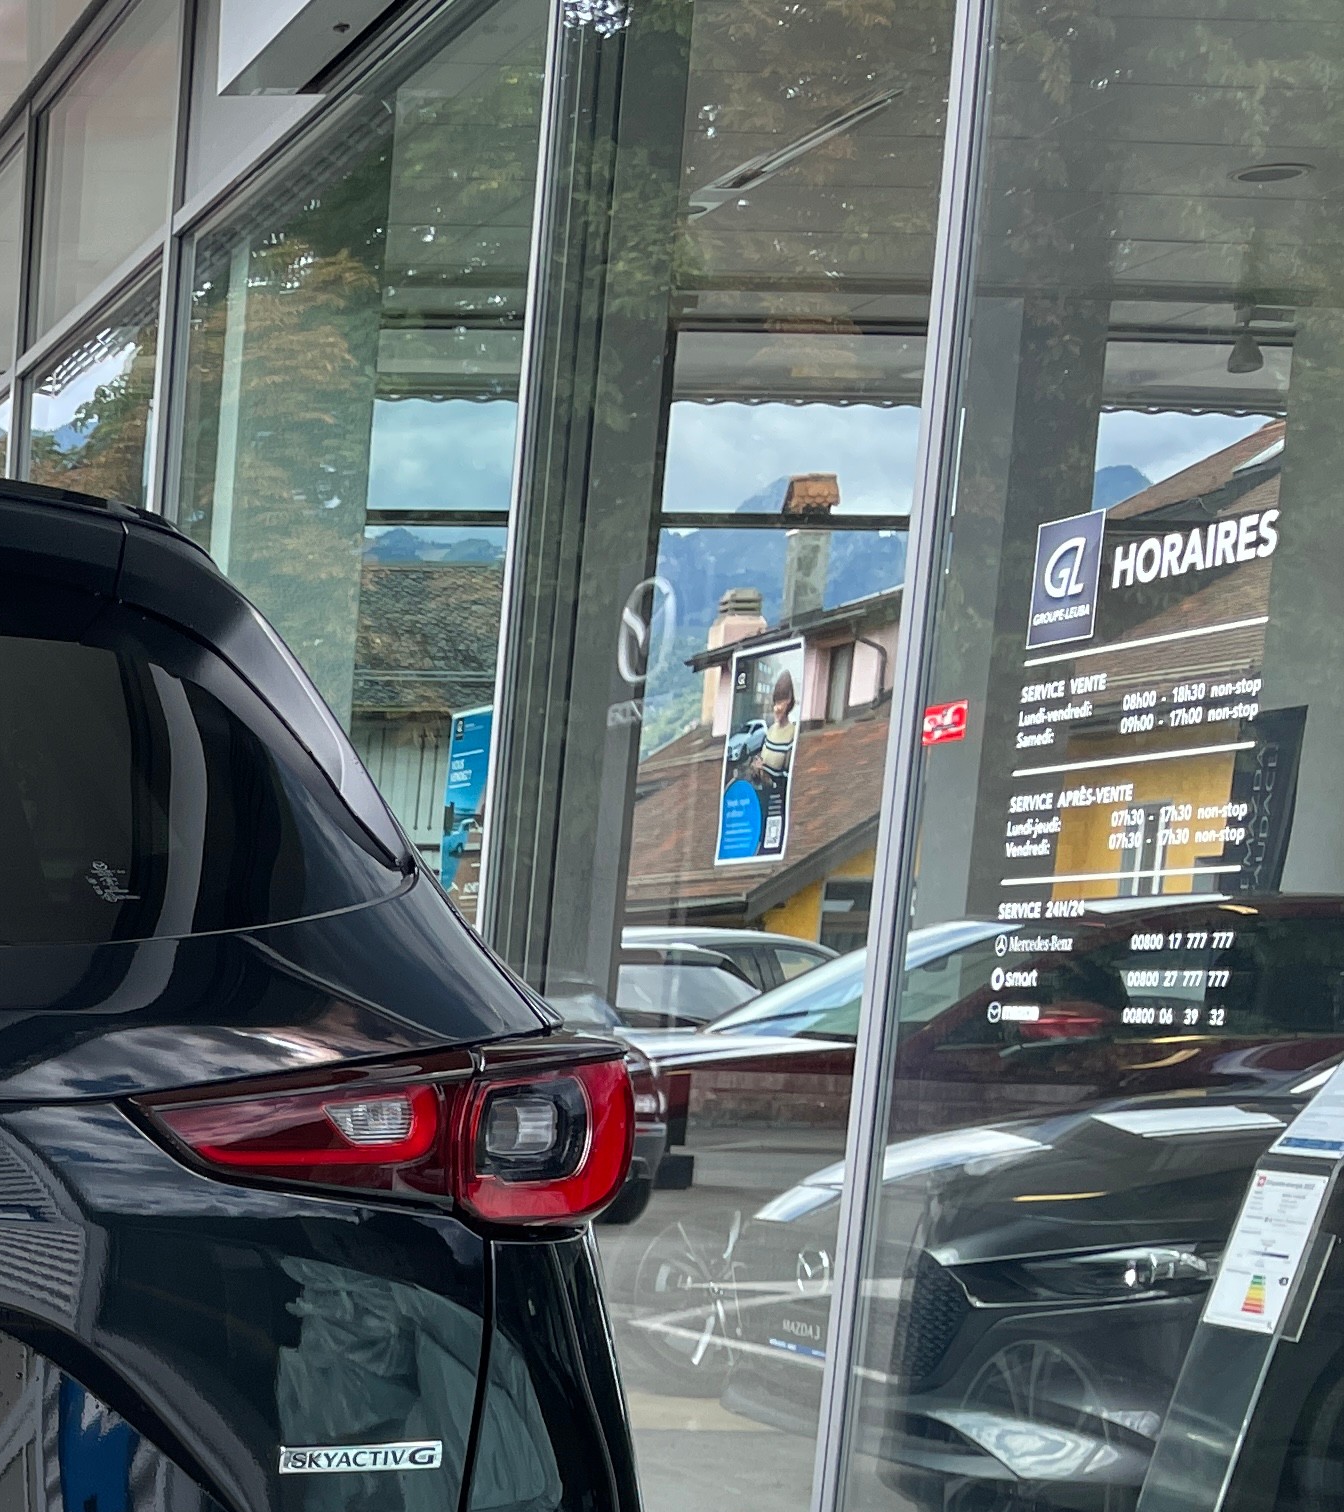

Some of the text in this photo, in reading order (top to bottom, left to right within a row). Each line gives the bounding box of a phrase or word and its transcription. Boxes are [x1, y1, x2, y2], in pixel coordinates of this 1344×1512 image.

[1112, 509, 1279, 589] HORAIRES
[1021, 673, 1108, 703] SERVICE VENTE
[1122, 691, 1157, 711] 08h00
[1172, 683, 1205, 704] 18h30
[1211, 678, 1261, 700] non-stop
[1018, 701, 1093, 727] Lundi-vendredi:
[1120, 714, 1154, 734] 09h00
[1169, 706, 1202, 727] 17h00
[1208, 702, 1259, 724] non-stop
[1015, 728, 1055, 748] Samedi:
[1009, 784, 1133, 814] SERVICE APRÈS-VENTE
[1111, 808, 1145, 828] 07h30
[1160, 804, 1192, 824] 17h30
[1197, 802, 1248, 824] non-stop
[1006, 816, 1062, 839] Lundi-jeudi:
[1108, 832, 1142, 850] 07h30
[1157, 827, 1190, 847] 17h30
[1194, 825, 1246, 846] non-stop
[1005, 839, 1051, 858] Vendredi:
[998, 900, 1086, 921] SERVICE 24H/24
[1009, 934, 1074, 953] Mercedes-Benz
[1131, 931, 1234, 951] 00800 17 777 777
[1004, 968, 1039, 988] smart
[1127, 970, 1230, 988] 00800 27 777 777
[1122, 1006, 1225, 1026] 00800 06 39 32
